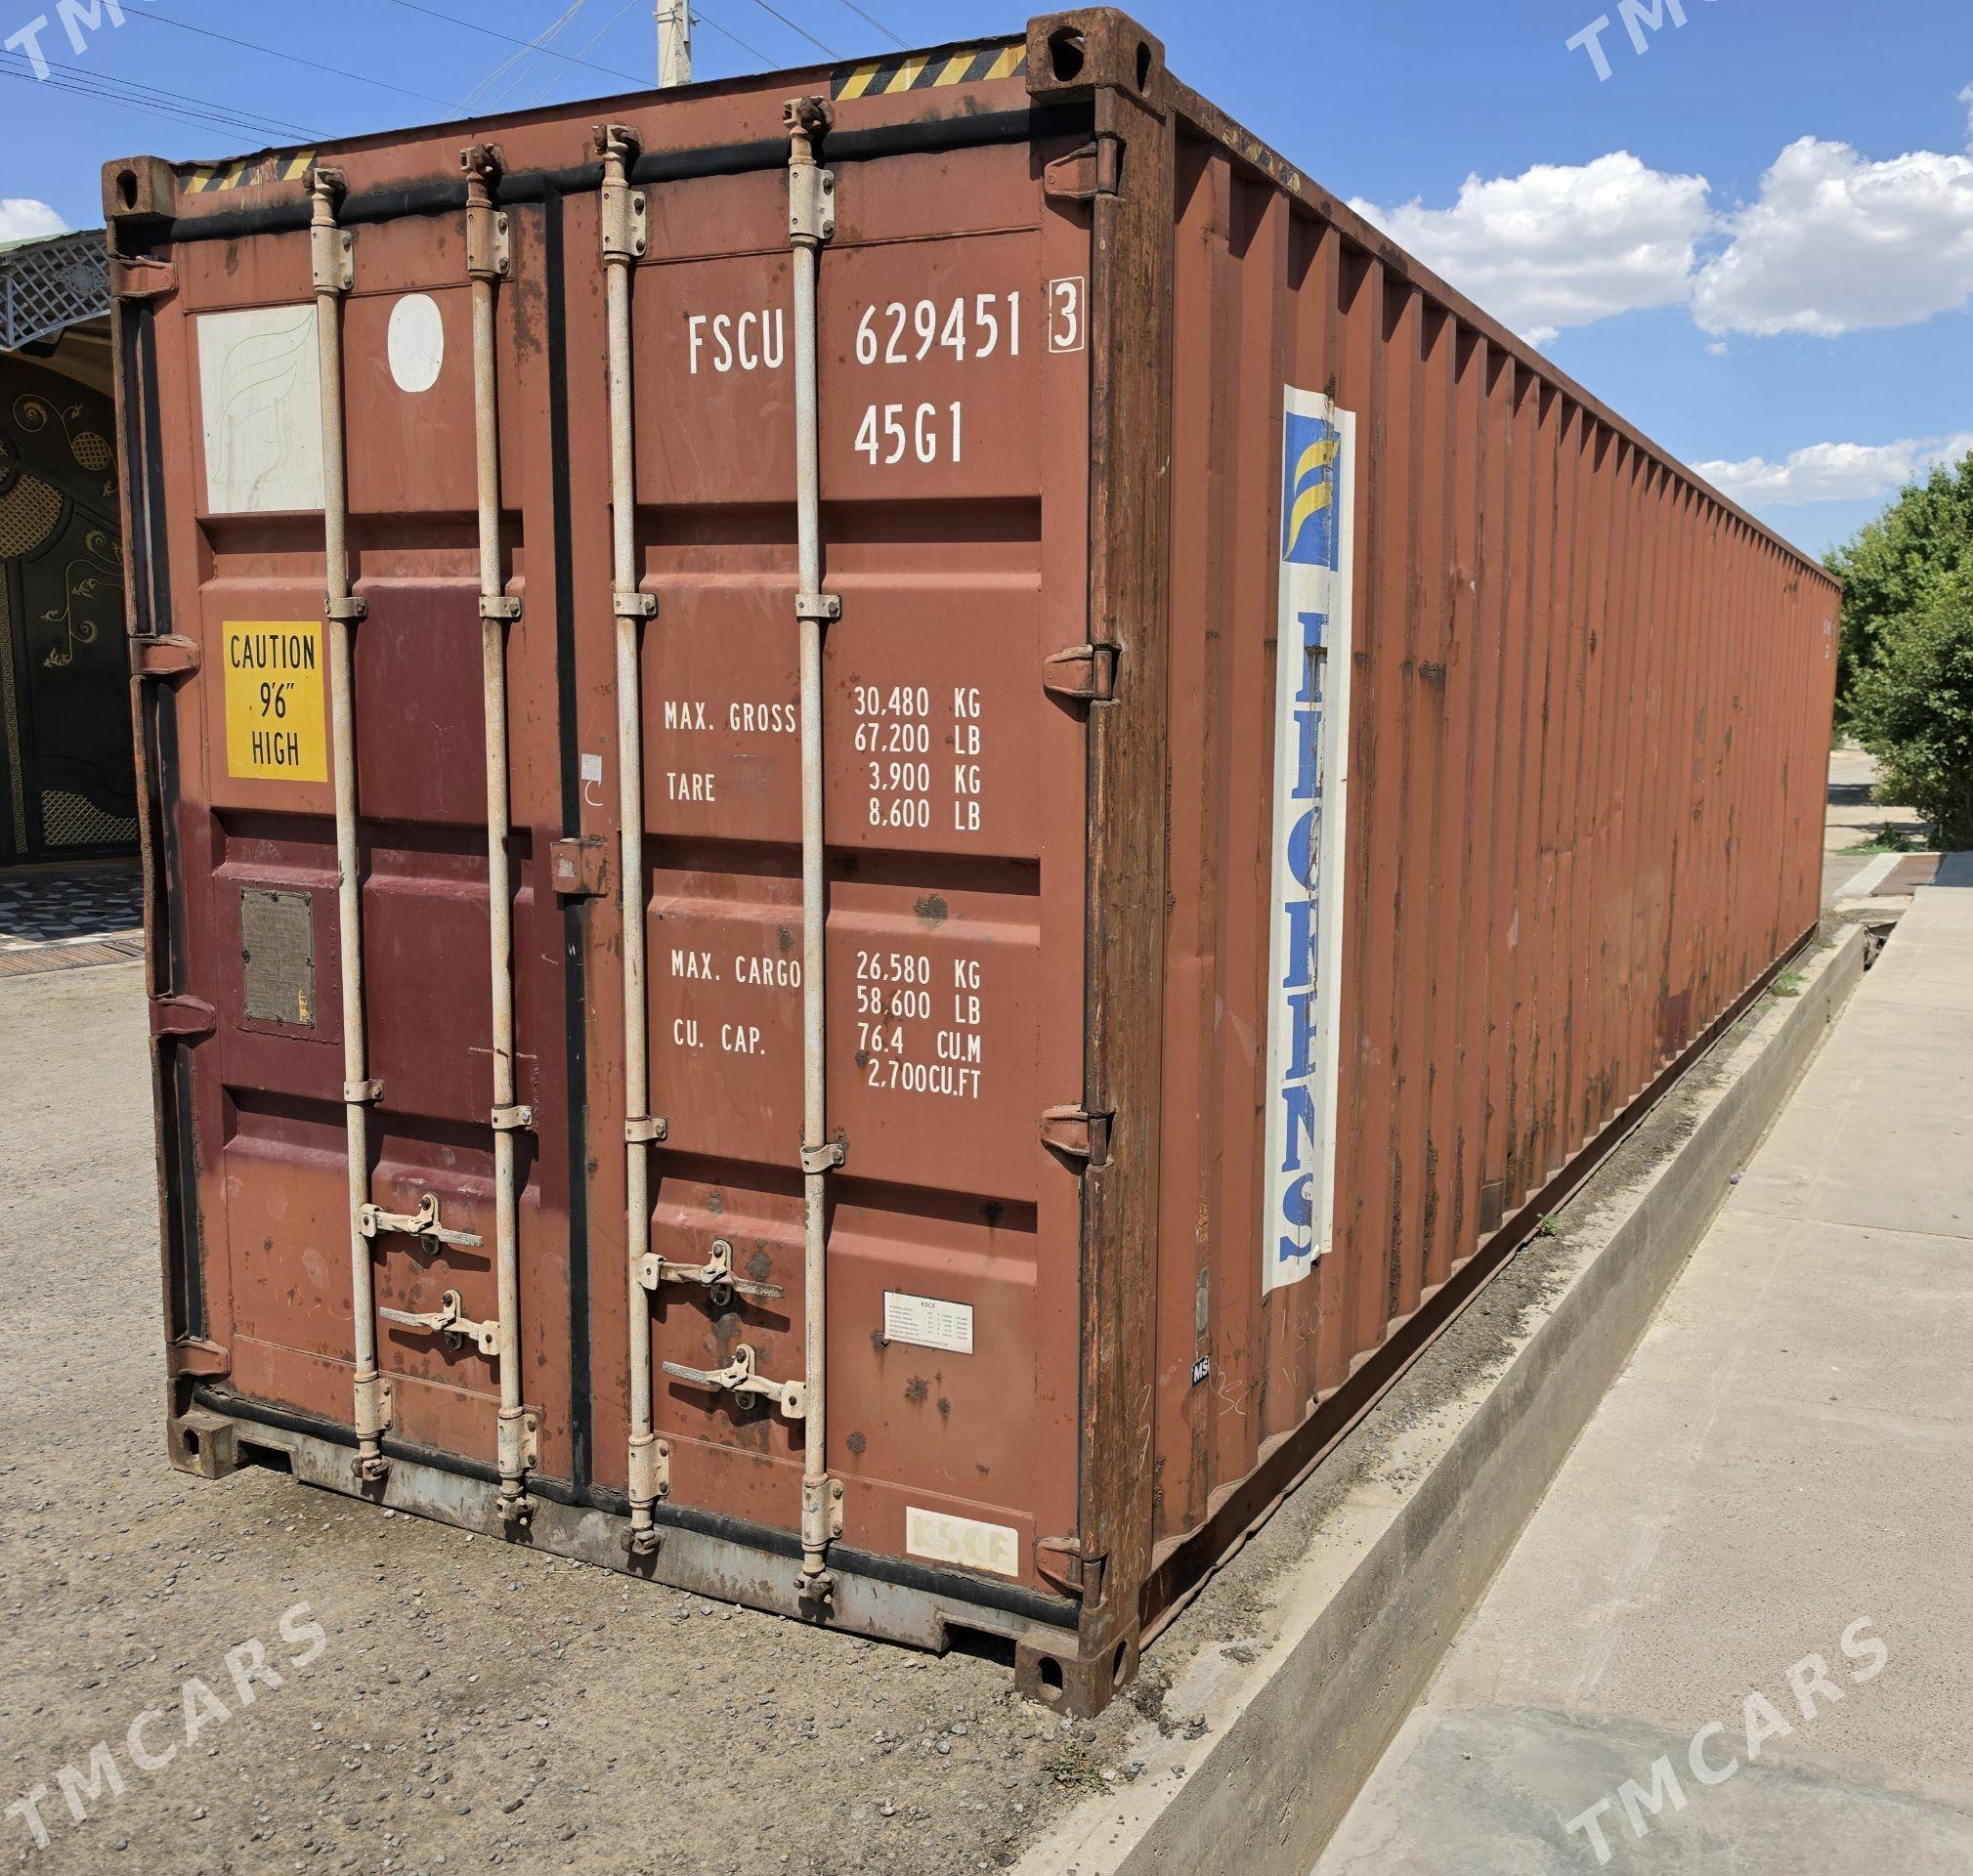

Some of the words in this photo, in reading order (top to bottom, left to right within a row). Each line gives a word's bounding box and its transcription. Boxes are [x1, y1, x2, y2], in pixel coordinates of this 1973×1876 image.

[690, 309, 783, 373] FSCU
[856, 291, 1018, 364] 629451
[1053, 281, 1076, 346] 3
[855, 402, 960, 464] 45G1
[232, 635, 314, 669] CAUTION
[665, 702, 712, 730] MAX.
[730, 704, 795, 732] GROSS
[955, 688, 979, 717] KG
[252, 732, 298, 765] HIGH
[956, 725, 979, 754] LB
[667, 773, 714, 801] TARE
[956, 765, 980, 793] KG
[956, 801, 979, 830] LB
[672, 950, 719, 980] MAX.
[736, 957, 800, 987] CARGO
[955, 959, 979, 989] KG
[956, 995, 980, 1024] LB
[674, 1019, 703, 1047] CU.
[722, 1024, 764, 1054] CAP.
[858, 1023, 903, 1053] 76.4
[937, 1031, 980, 1062] CU.M
[913, 1515, 1008, 1562] KSCF
